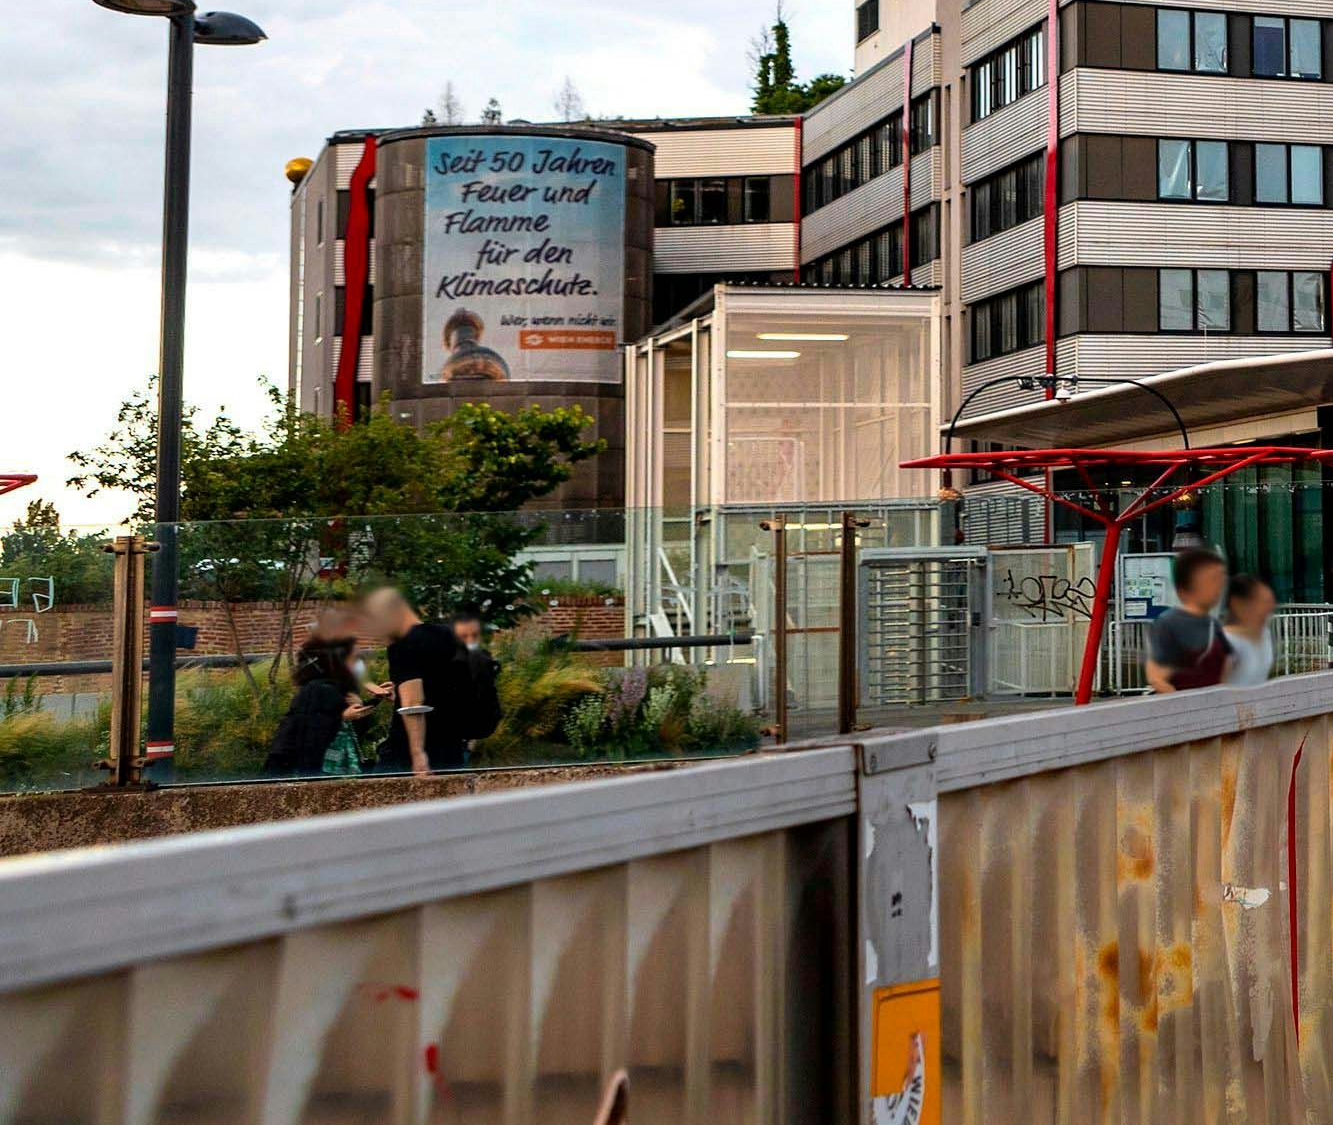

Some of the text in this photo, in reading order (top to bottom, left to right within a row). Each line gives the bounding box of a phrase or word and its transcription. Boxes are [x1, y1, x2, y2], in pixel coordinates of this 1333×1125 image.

[434, 147, 616, 176] Seit 50 Jahren
[461, 179, 597, 204] Feuer und
[444, 209, 550, 235] Flamme
[475, 238, 573, 269] für den
[435, 269, 598, 300] Klimaschutz.
